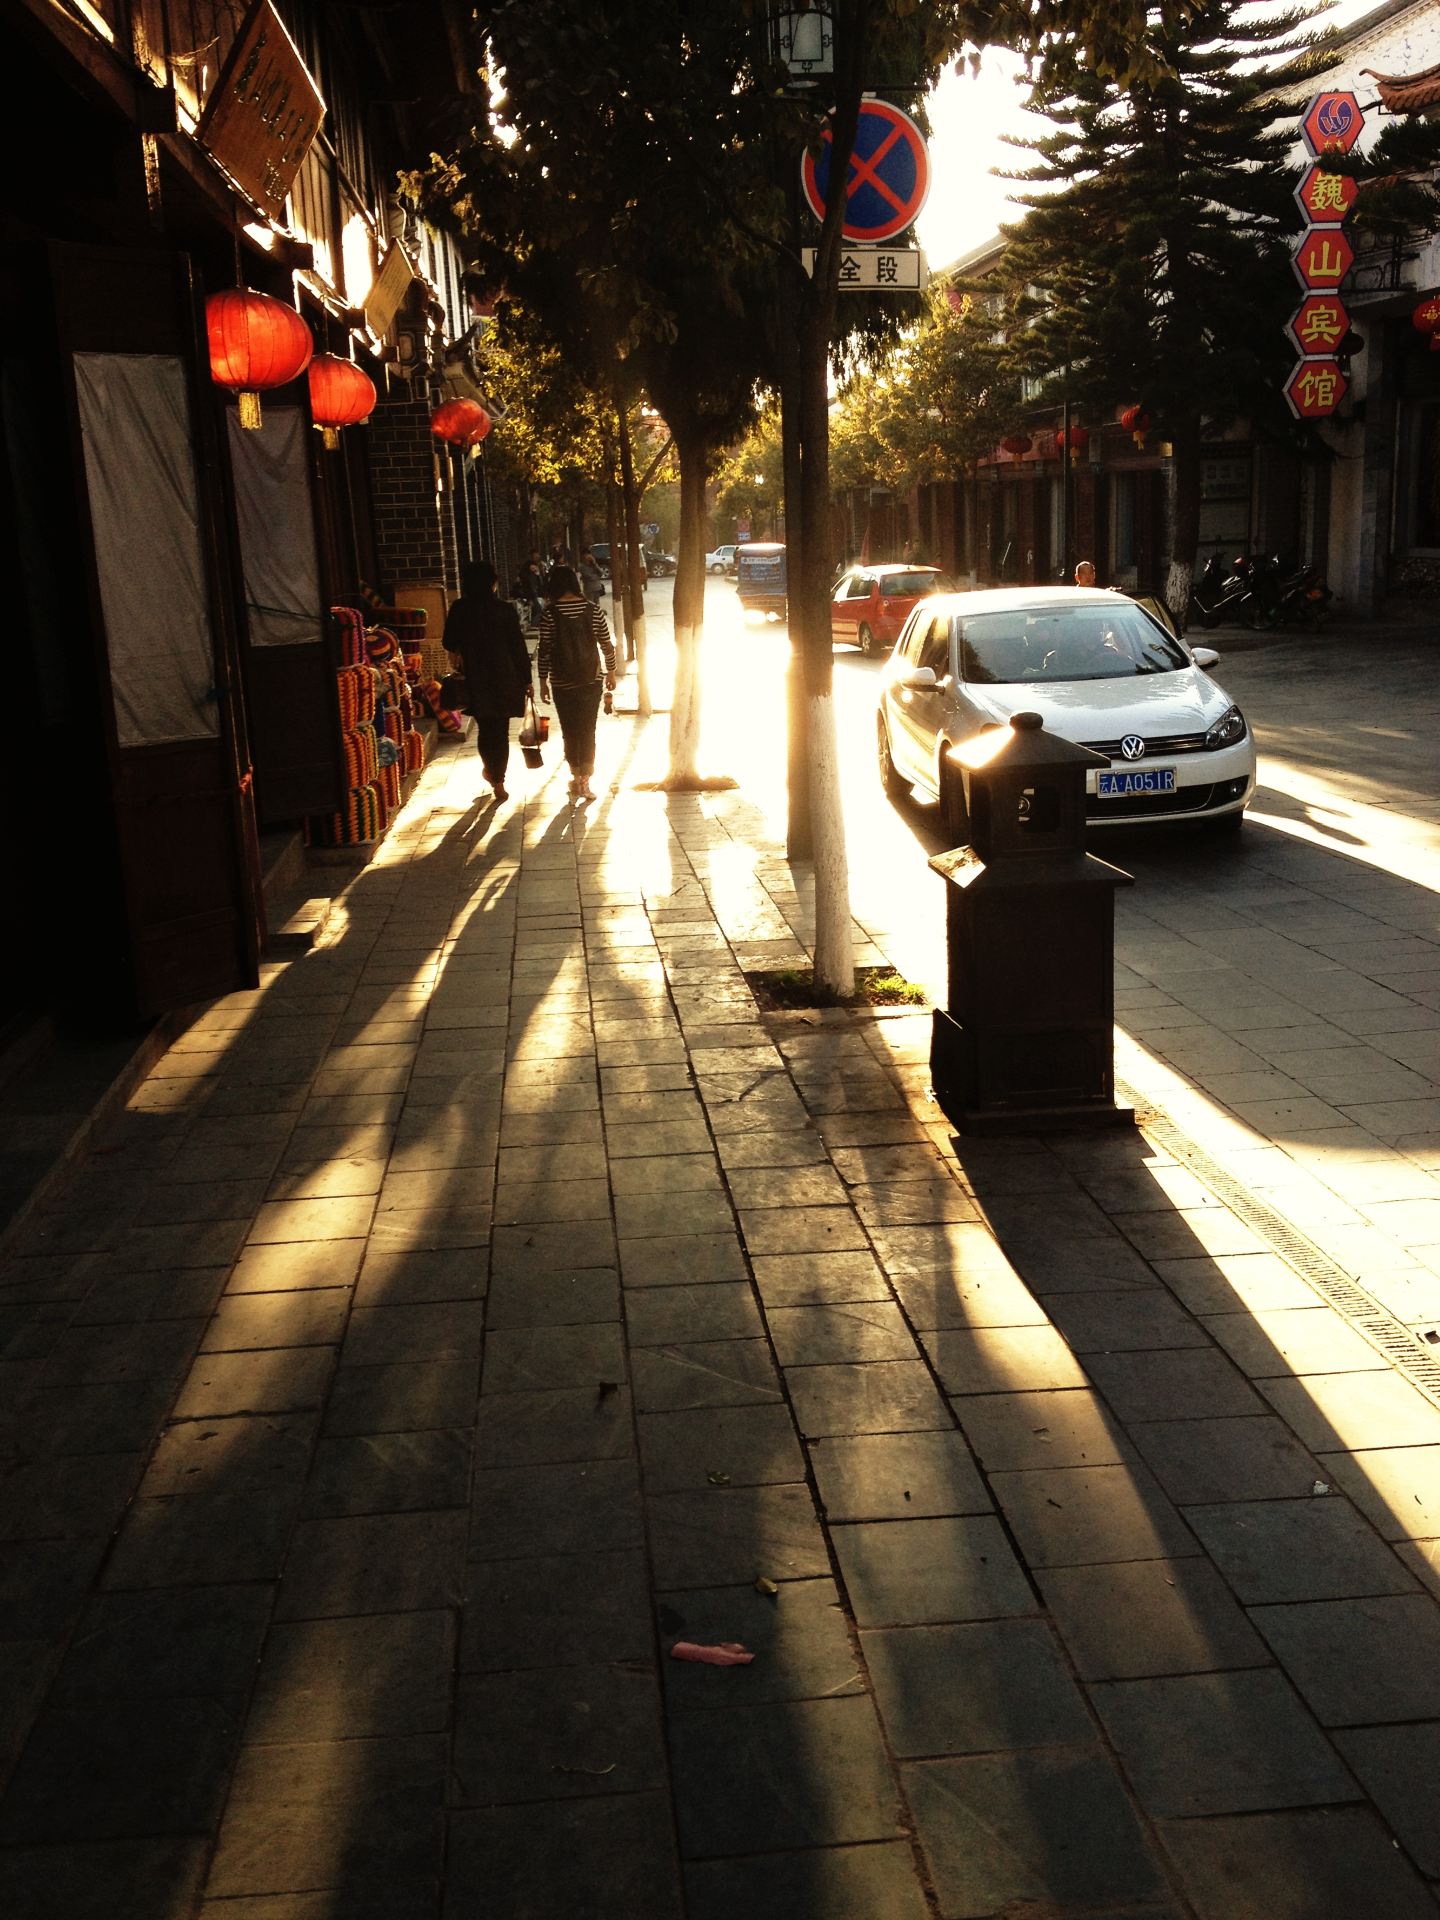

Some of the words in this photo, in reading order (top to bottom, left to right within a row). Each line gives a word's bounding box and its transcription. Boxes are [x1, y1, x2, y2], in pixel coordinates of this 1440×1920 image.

[839, 255, 898, 283] 全段
[1298, 171, 1348, 408] 巍山宾馆
